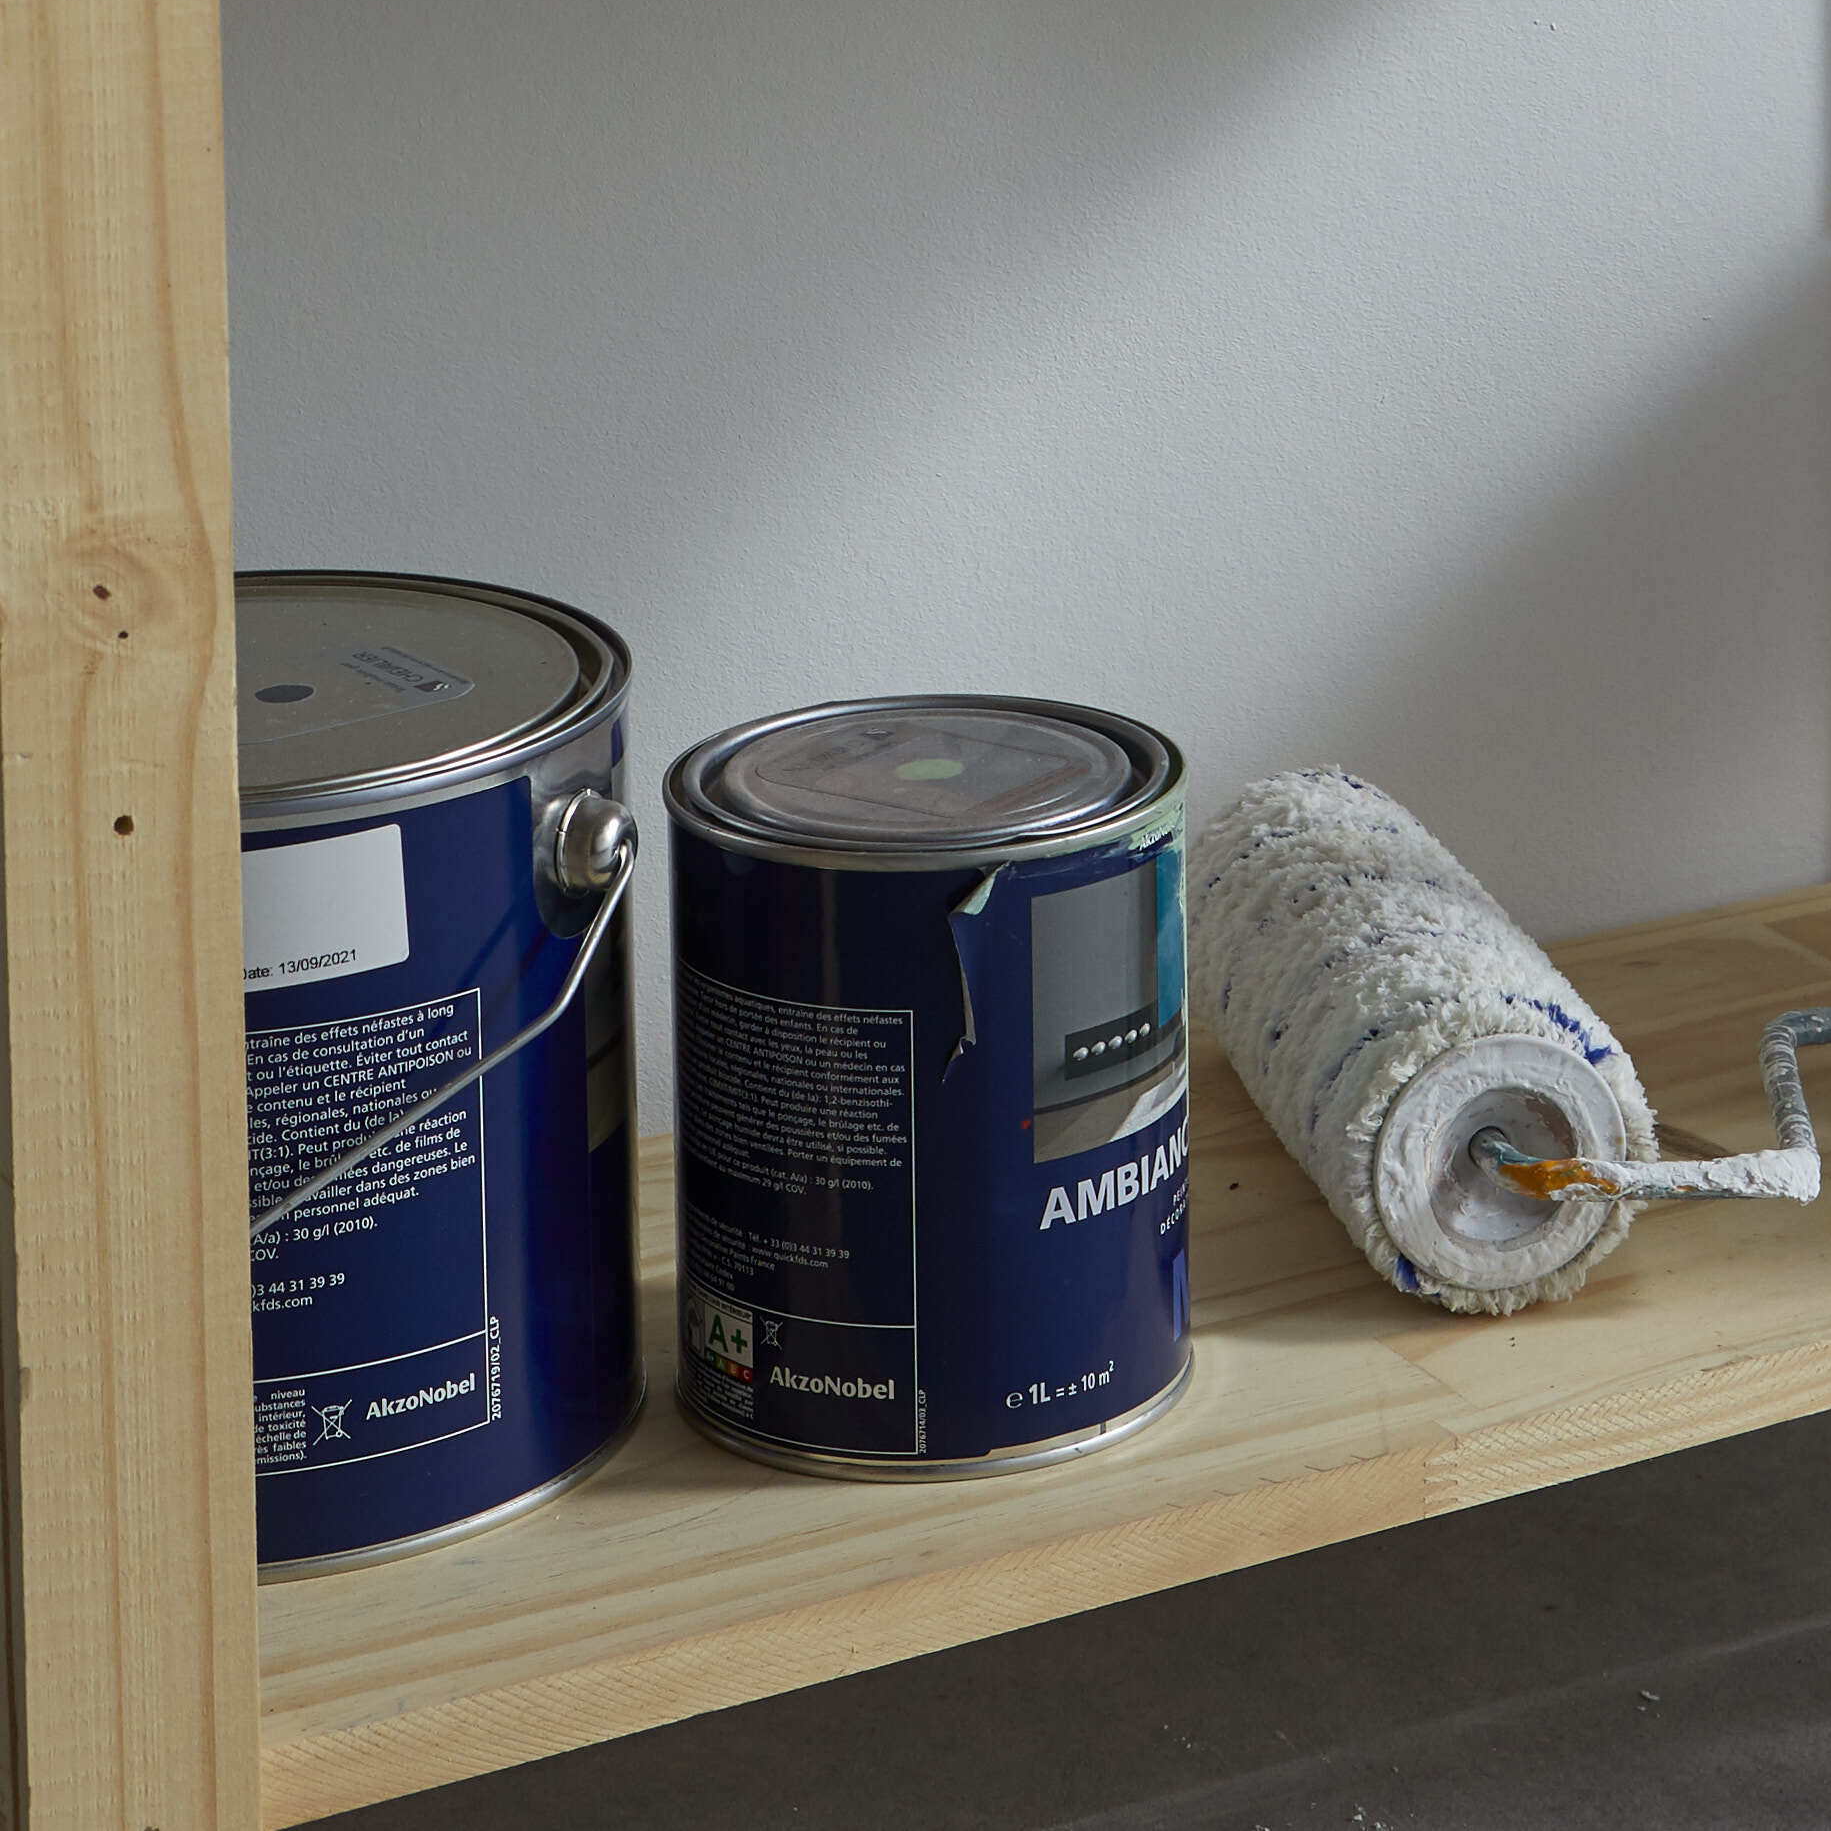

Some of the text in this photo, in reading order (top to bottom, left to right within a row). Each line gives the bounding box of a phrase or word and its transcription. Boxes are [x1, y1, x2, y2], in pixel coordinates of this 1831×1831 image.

[278, 948, 358, 976] 13/09/2021
[294, 1003, 455, 1046] des effets néfastes à long
[816, 1010, 833, 1022] des
[833, 1012, 861, 1025] effets
[863, 1013, 904, 1026] néfastes
[816, 1022, 828, 1033] En
[830, 1024, 845, 1035] cas
[846, 1025, 860, 1036] de
[247, 1027, 426, 1066] En cas de consultation d'un
[819, 1034, 829, 1046] le
[830, 1037, 872, 1050] récipient
[872, 1040, 888, 1050] ou
[255, 1069, 275, 1082] ou
[278, 1057, 353, 1079] l'étiquette.
[355, 1048, 394, 1067] Éviter
[395, 1042, 423, 1059] tout
[425, 1029, 469, 1053] contact
[815, 1047, 838, 1059] peau
[840, 1049, 854, 1059] ou
[855, 1049, 869, 1060] les
[302, 1078, 320, 1091] un
[323, 1068, 375, 1088] CENTRE
[377, 1048, 454, 1079] ANTIPOISON
[456, 1045, 473, 1059] ou
[804, 1058, 817, 1068] ou
[818, 1060, 832, 1070] un
[833, 1061, 874, 1072] médecin
[875, 1064, 889, 1073] en
[890, 1064, 907, 1074] cas
[810, 1070, 880, 1085] conformément
[881, 1076, 901, 1086] aux
[257, 1078, 408, 1113] contenu et le récipient
[815, 1082, 829, 1093] ou
[830, 1083, 905, 1097] internationales.
[275, 1088, 439, 1128] régionales, nationales o
[819, 1107, 838, 1117] une
[839, 1107, 879, 1120] réaction
[280, 1113, 386, 1143] Contient du (de
[297, 1109, 468, 1156] Peut réaction
[818, 1116, 828, 1127] le
[828, 1118, 866, 1132] brûlage
[886, 1121, 901, 1132] de
[853, 1132, 871, 1144] des
[872, 1132, 908, 1145] fumées
[250, 1162, 294, 1179] nçage,
[298, 1159, 311, 1171] le
[394, 1139, 412, 1153] de
[413, 1131, 444, 1149] films
[445, 1126, 461, 1141] de
[846, 1144, 887, 1156] possible.
[254, 1139, 469, 1193] et/ou dangereuses. Le
[816, 1153, 829, 1163] un
[830, 1154, 888, 1168] équipement
[889, 1157, 904, 1168] de
[355, 1153, 476, 1194] dans des zones bien
[815, 1175, 827, 1187] 30
[841, 1177, 875, 1192] (2010).
[293, 1196, 359, 1222] personnel
[363, 1184, 420, 1209] adéquat.
[292, 1227, 309, 1242] 30
[312, 1222, 330, 1241] g/l
[333, 1214, 379, 1236] (2010).
[824, 1248, 837, 1259] 39
[838, 1249, 851, 1260] 39
[268, 1271, 346, 1294] 44 31 39 39
[252, 1295, 314, 1313] kfds.com
[708, 1312, 749, 1354] A+
[489, 1315, 503, 1422] 2076719/02_CLP
[768, 1365, 896, 1401] AkzoNobel
[1028, 1380, 1052, 1406] 1L
[1080, 1371, 1096, 1392] 10
[270, 1388, 306, 1401] niveau
[365, 1371, 476, 1421] AkzoNobel
[254, 1399, 306, 1413] ubstances
[293, 1429, 307, 1440] de
[256, 1448, 308, 1465] missions).
[272, 1440, 307, 1453] faibles
